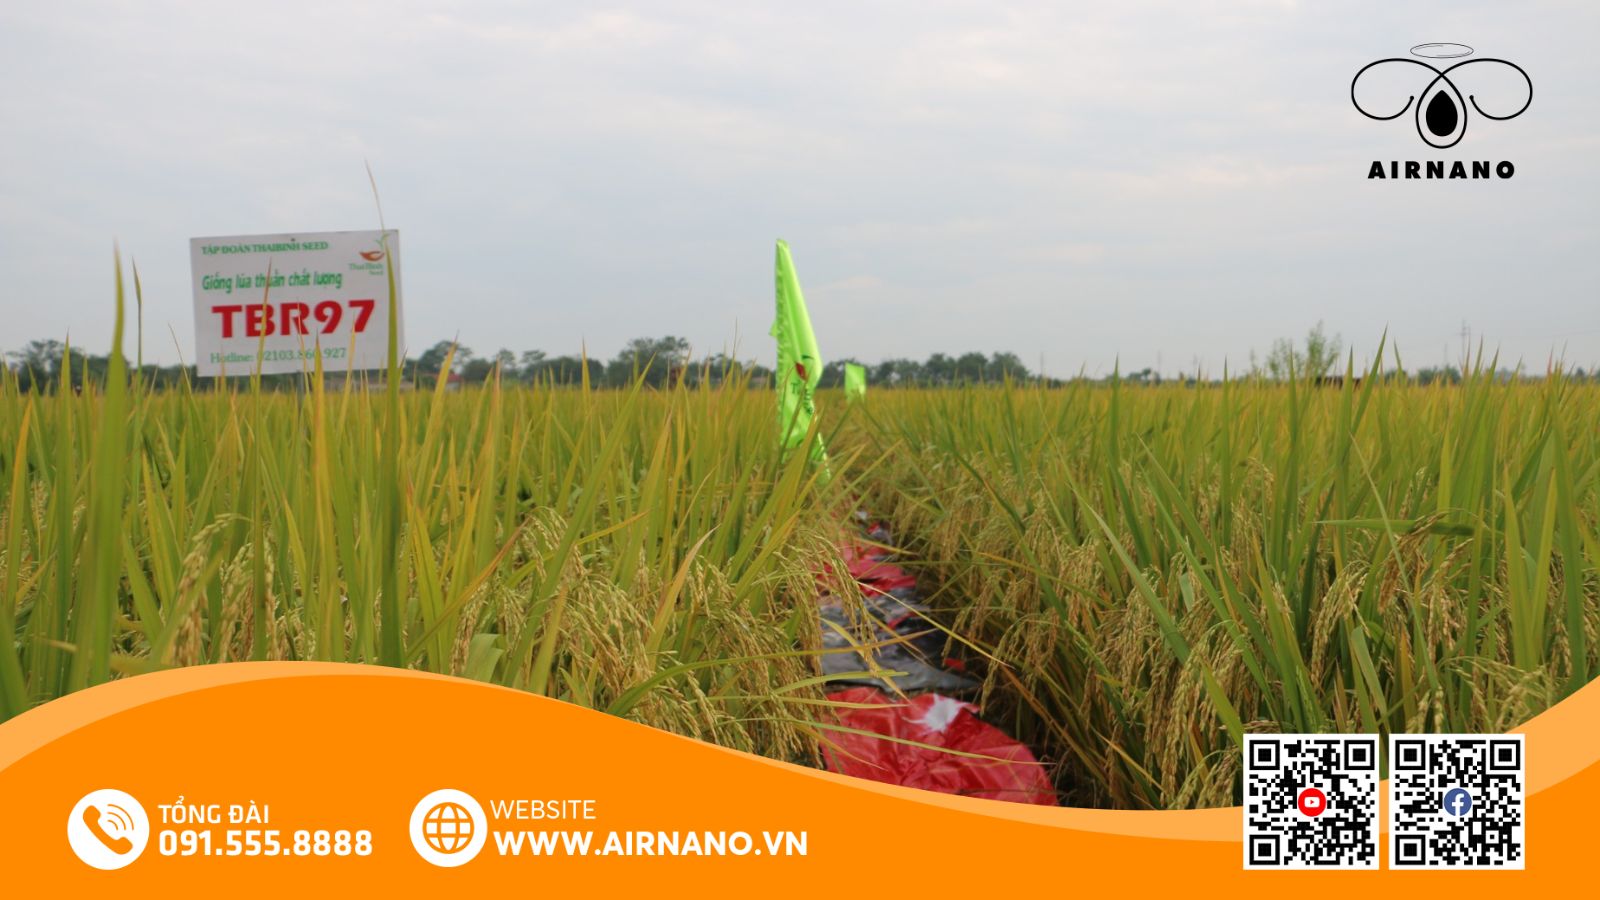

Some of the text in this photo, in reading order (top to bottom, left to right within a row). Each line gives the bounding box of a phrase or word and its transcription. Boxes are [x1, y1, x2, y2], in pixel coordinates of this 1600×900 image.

[302, 241, 329, 251] SEED
[202, 271, 232, 294] Giống
[235, 273, 252, 289] lúa
[288, 267, 311, 287] chất
[211, 299, 375, 338] TBR97
